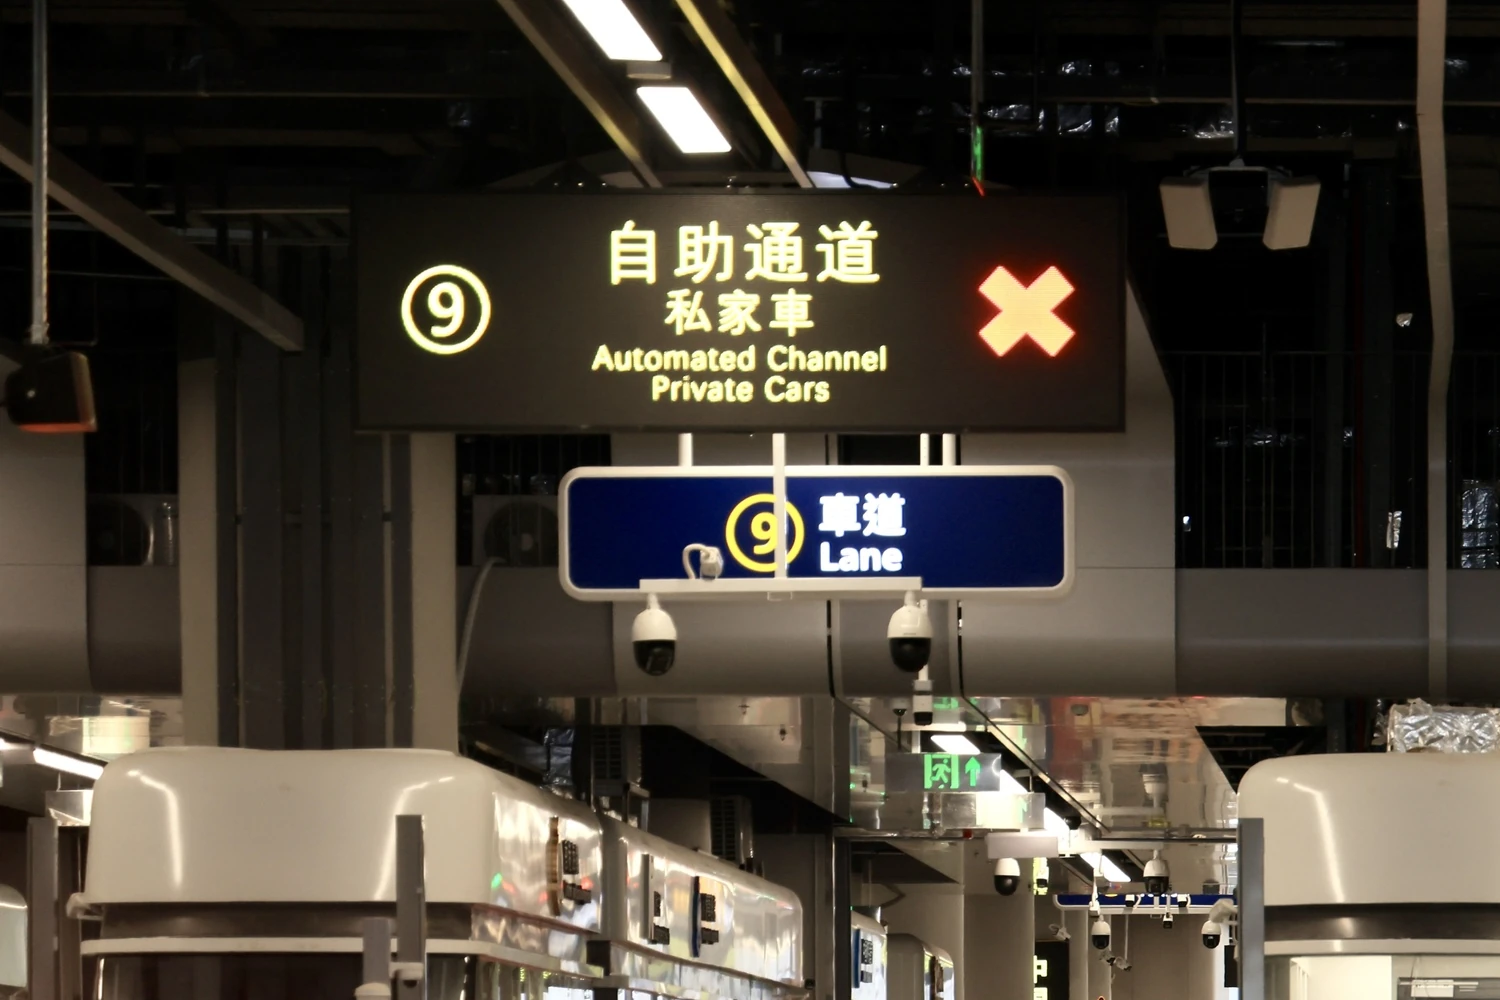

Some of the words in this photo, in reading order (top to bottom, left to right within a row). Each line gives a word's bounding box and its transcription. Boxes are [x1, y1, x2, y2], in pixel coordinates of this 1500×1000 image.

[610, 219, 880, 285] 自助通道
[430, 280, 465, 338] 9
[664, 289, 815, 336] 私家車
[592, 344, 756, 373] Automated
[767, 344, 888, 373] Channel
[652, 375, 754, 403] Private
[764, 375, 830, 403] Cars
[818, 492, 907, 538] 車道
[820, 541, 903, 572] Lane
